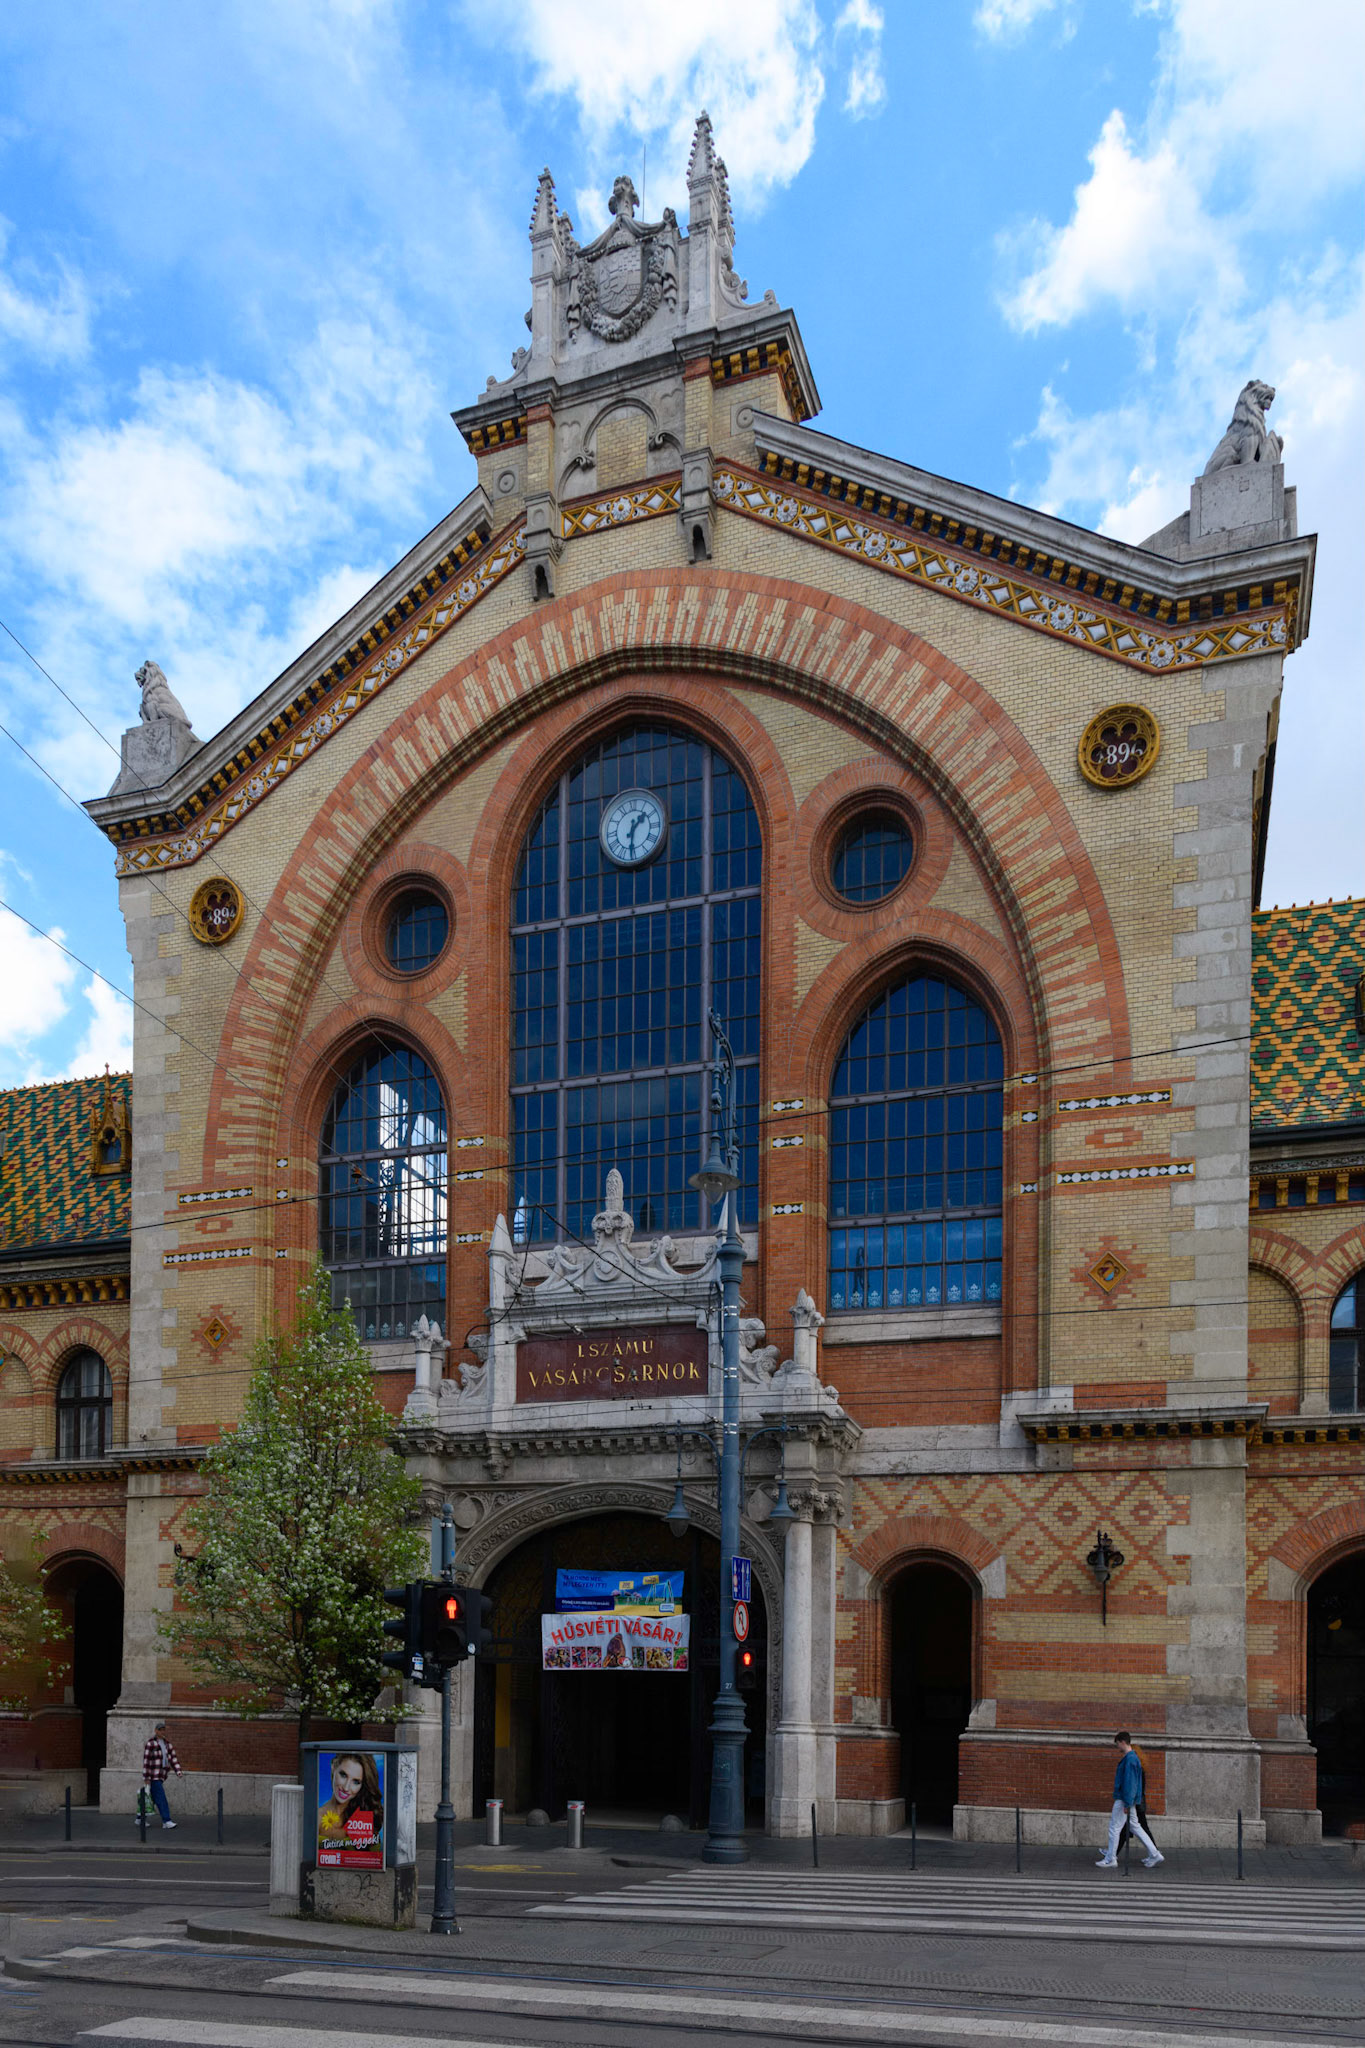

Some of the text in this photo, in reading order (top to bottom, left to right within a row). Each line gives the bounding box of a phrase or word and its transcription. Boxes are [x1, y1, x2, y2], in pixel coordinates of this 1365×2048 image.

[551, 1616, 682, 1645] HÚSVÉTI VÁSÁR!
[725, 1682, 733, 1690] 27
[347, 1820, 373, 1830] 200m
